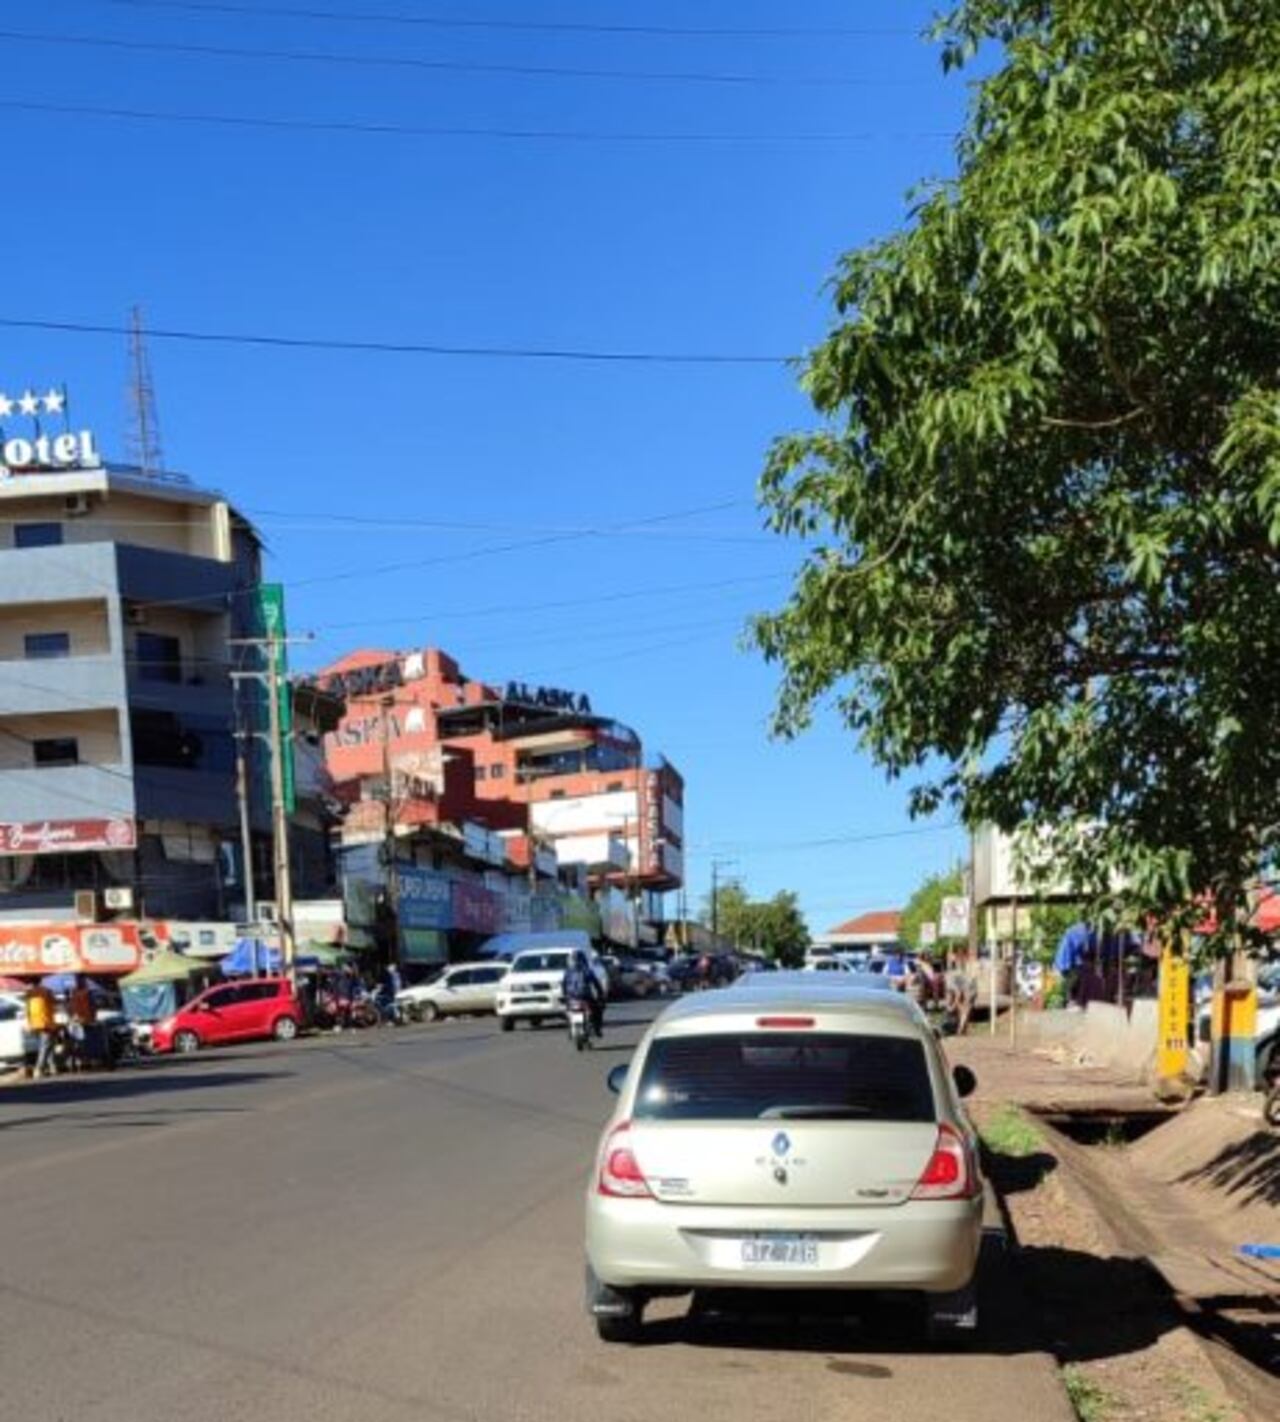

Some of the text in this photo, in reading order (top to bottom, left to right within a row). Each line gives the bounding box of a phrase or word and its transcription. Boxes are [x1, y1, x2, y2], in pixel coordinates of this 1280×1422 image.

[0, 429, 101, 468] otel
[506, 680, 592, 713] ALASKA
[325, 714, 400, 748] ASKA
